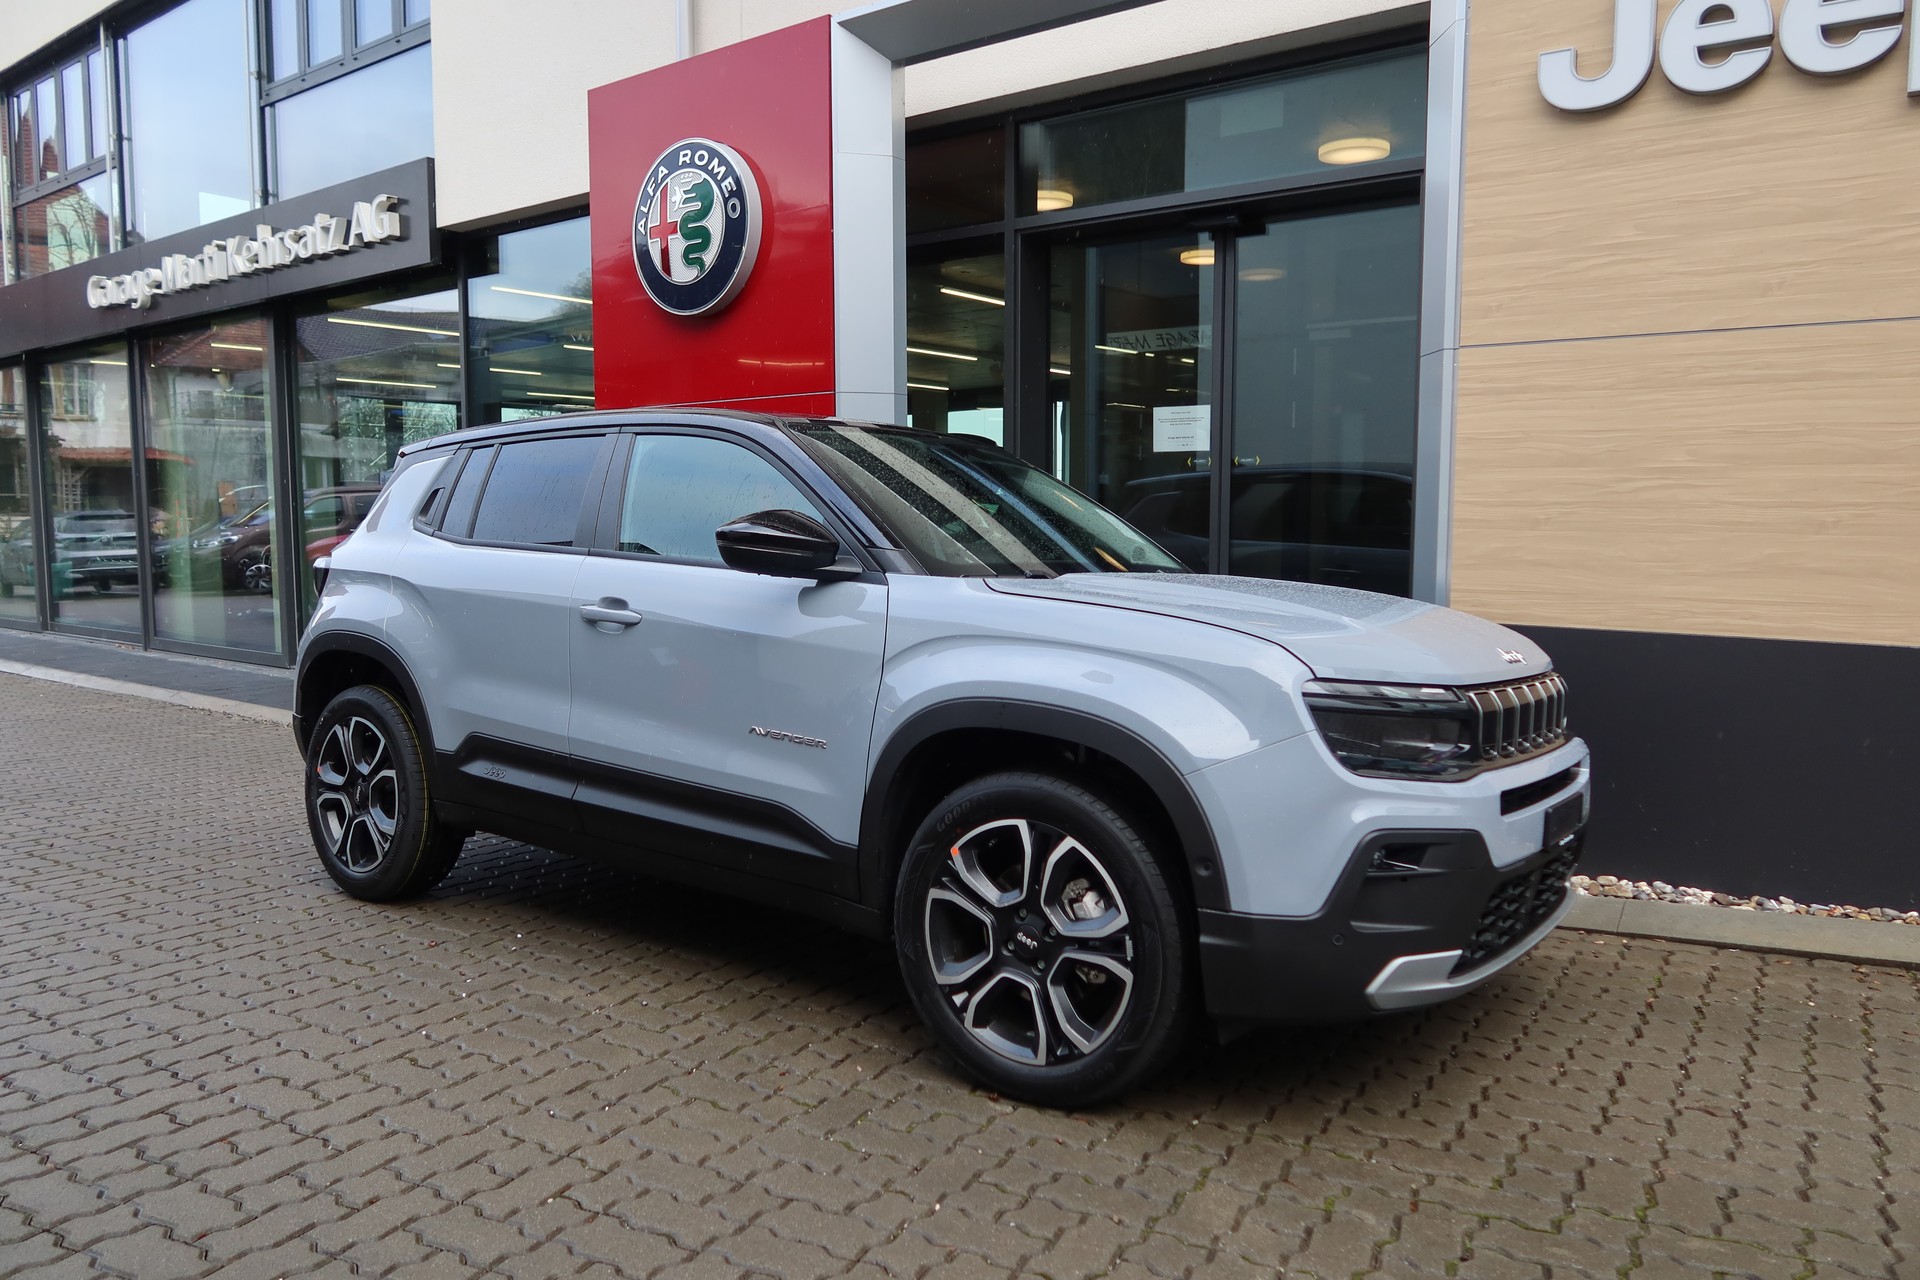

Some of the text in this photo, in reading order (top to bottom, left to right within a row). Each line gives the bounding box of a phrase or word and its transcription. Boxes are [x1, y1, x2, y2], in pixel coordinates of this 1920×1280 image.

[1537, 0, 1920, 113] Jee
[638, 149, 741, 235] ALFA ROMEO
[86, 193, 400, 309] Garage Marti Kehrsatz AG
[748, 725, 827, 749] AVENGER
[484, 763, 507, 780] Jeep
[1016, 931, 1038, 950] Jeep
